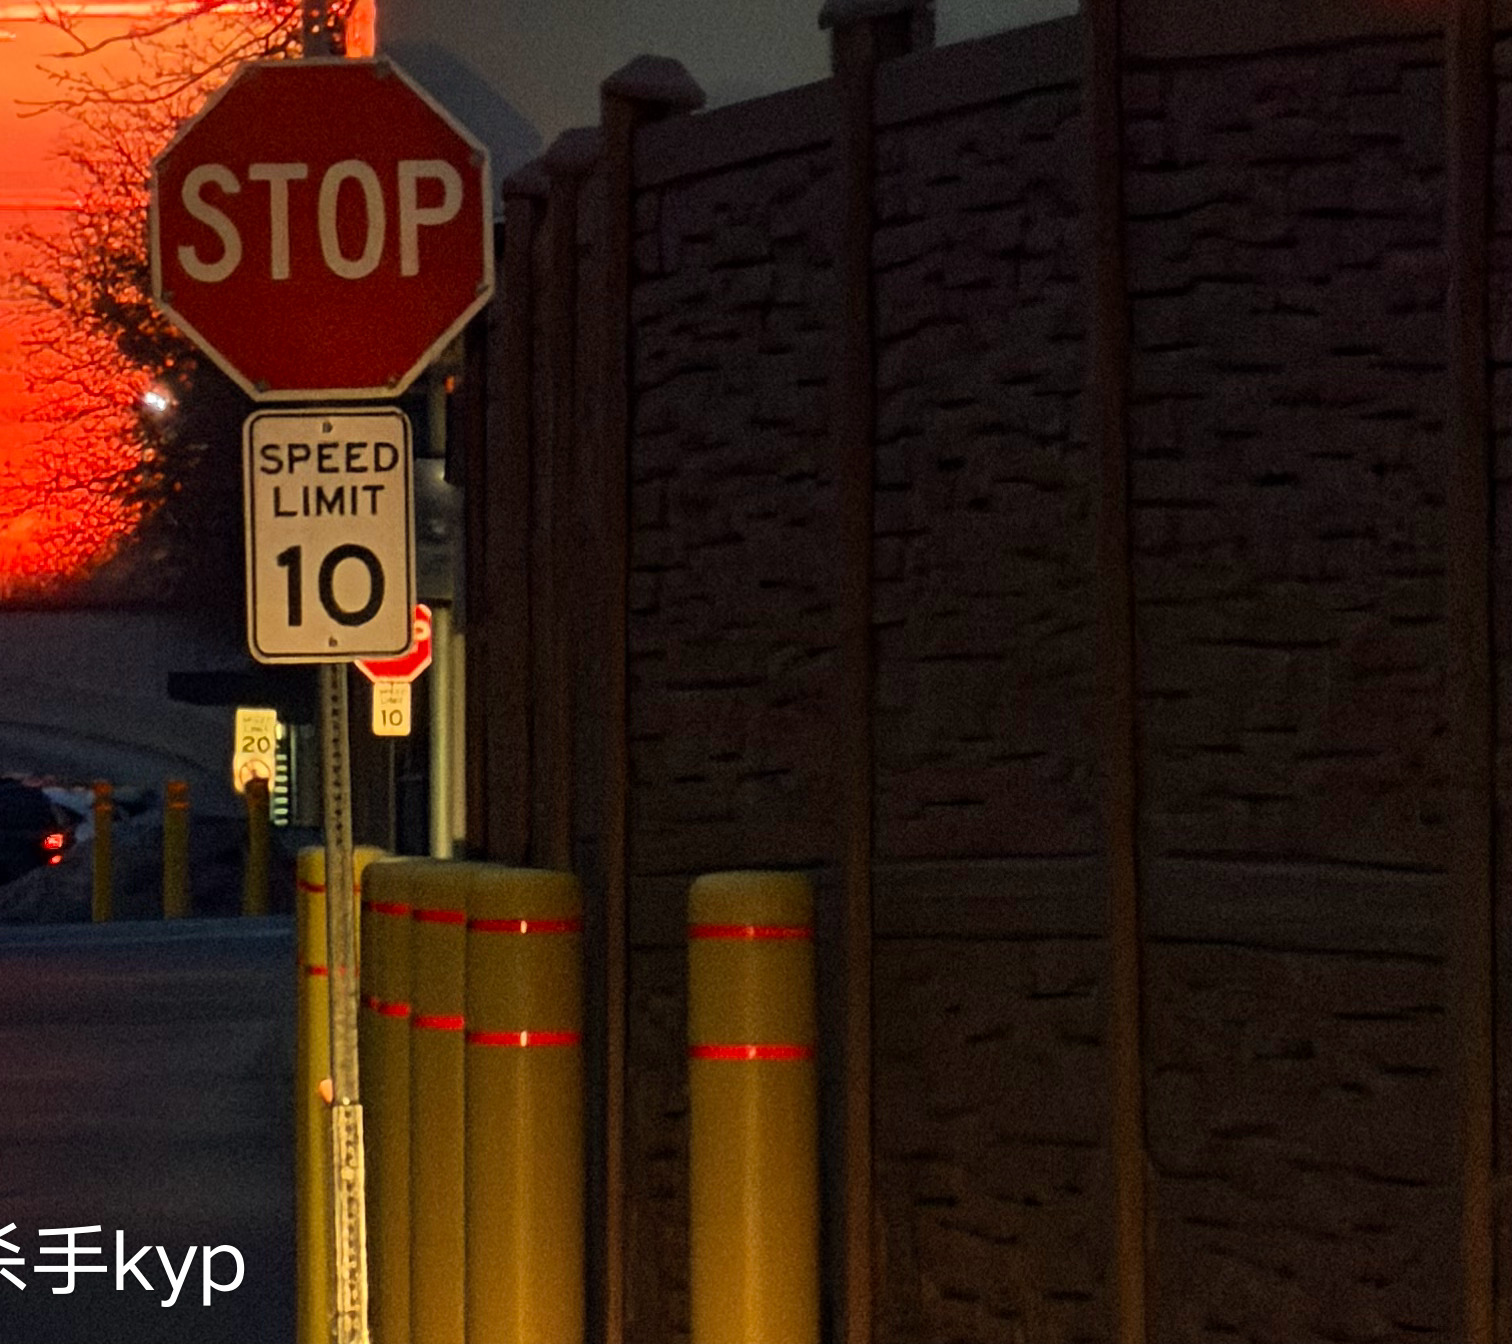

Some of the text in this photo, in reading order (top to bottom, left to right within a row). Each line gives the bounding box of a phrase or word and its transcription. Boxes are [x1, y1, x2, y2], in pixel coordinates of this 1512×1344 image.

[178, 159, 463, 282] STOP
[259, 441, 400, 476] SPEED
[272, 484, 386, 518] LIMIT
[275, 543, 386, 627] 10
[381, 709, 403, 727] 10
[242, 735, 271, 754] 20
